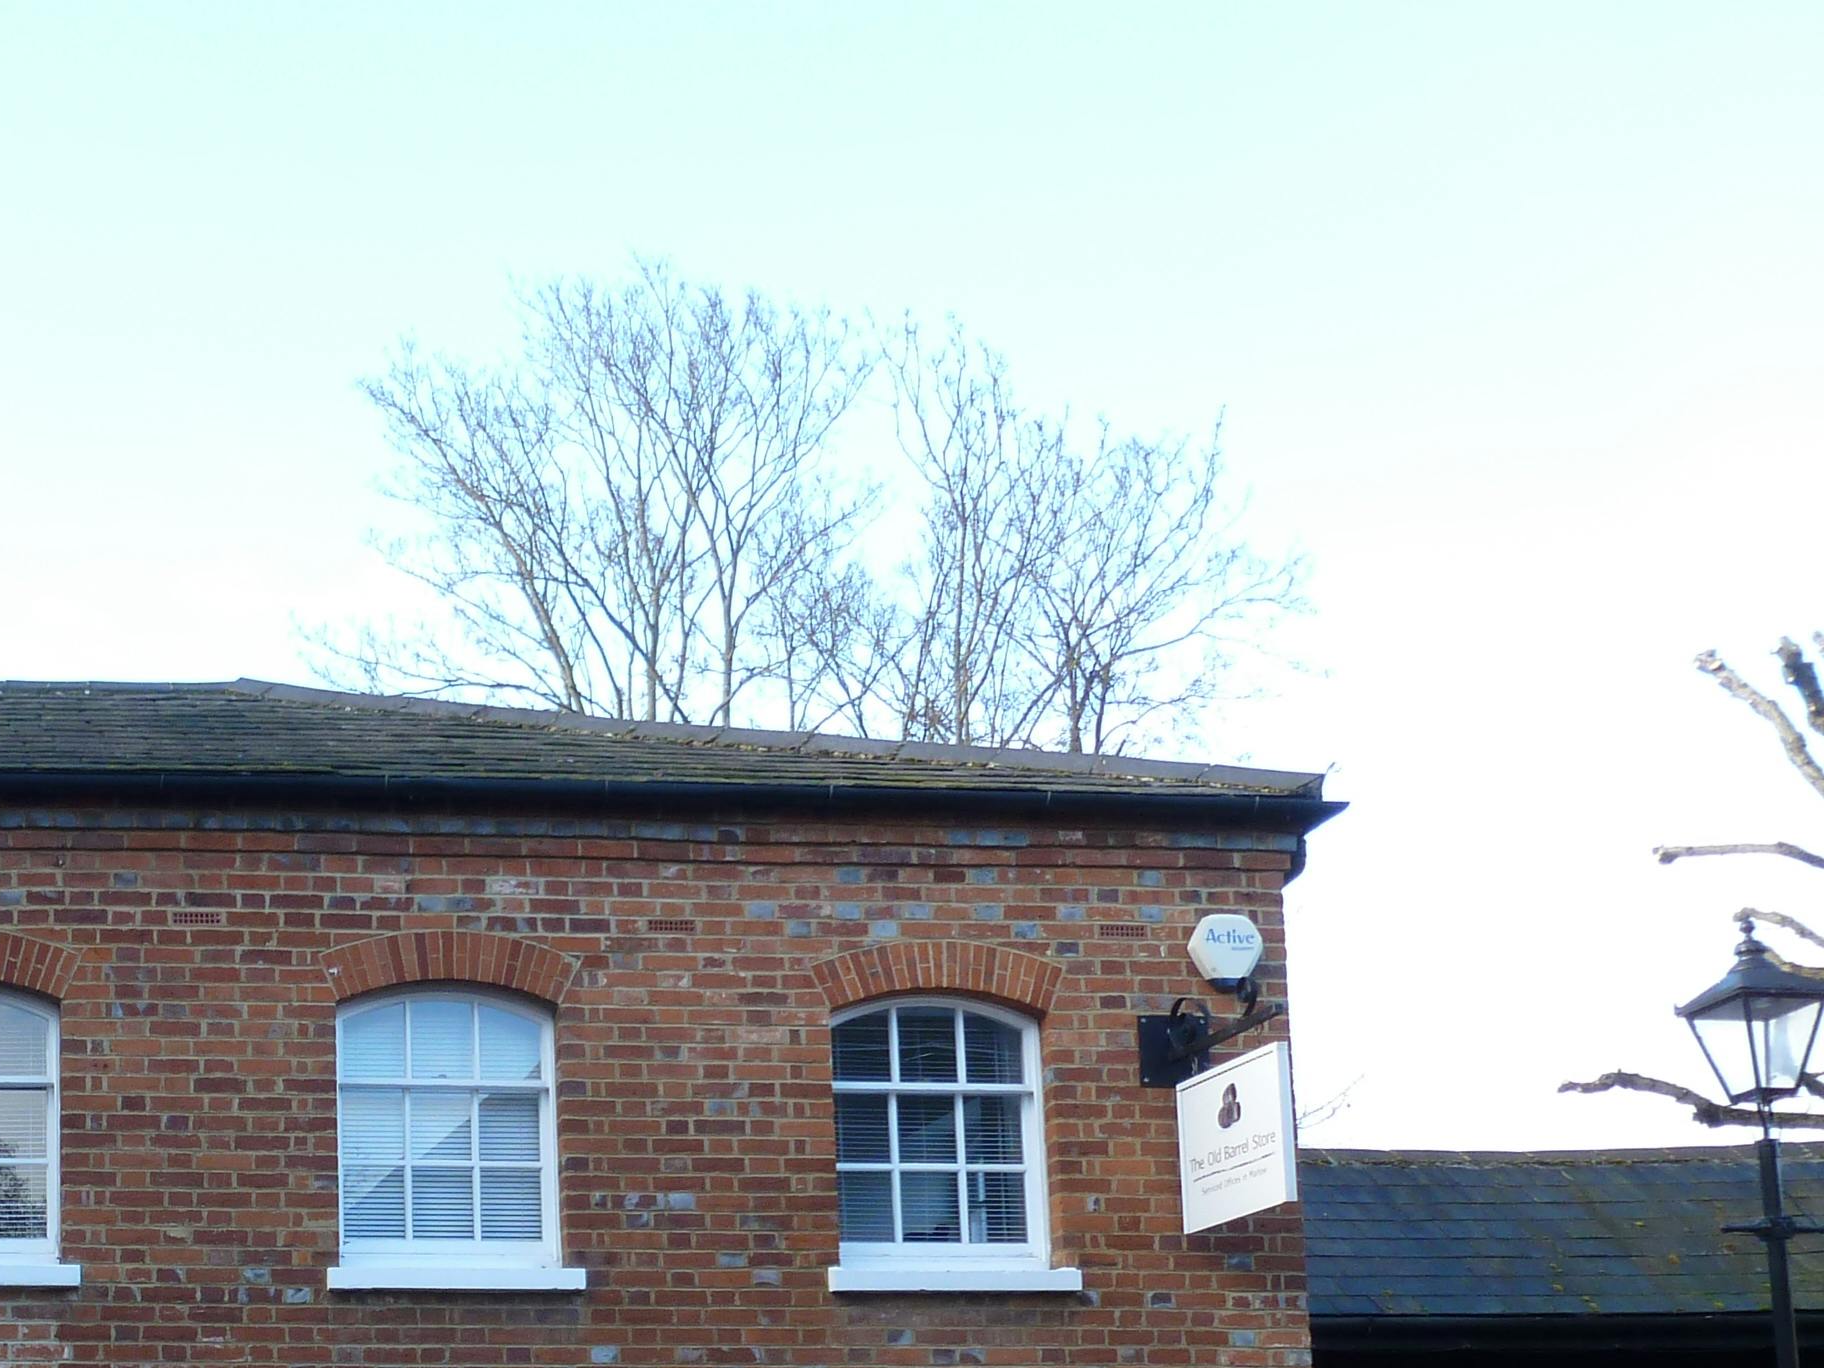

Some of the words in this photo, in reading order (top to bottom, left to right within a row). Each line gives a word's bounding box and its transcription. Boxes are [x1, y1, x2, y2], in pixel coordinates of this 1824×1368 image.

[1206, 928, 1255, 944] Active
[1189, 1156, 1205, 1173] The
[1208, 1147, 1222, 1166] Old
[1224, 1138, 1249, 1160] Barrel
[1252, 1131, 1276, 1150] Store
